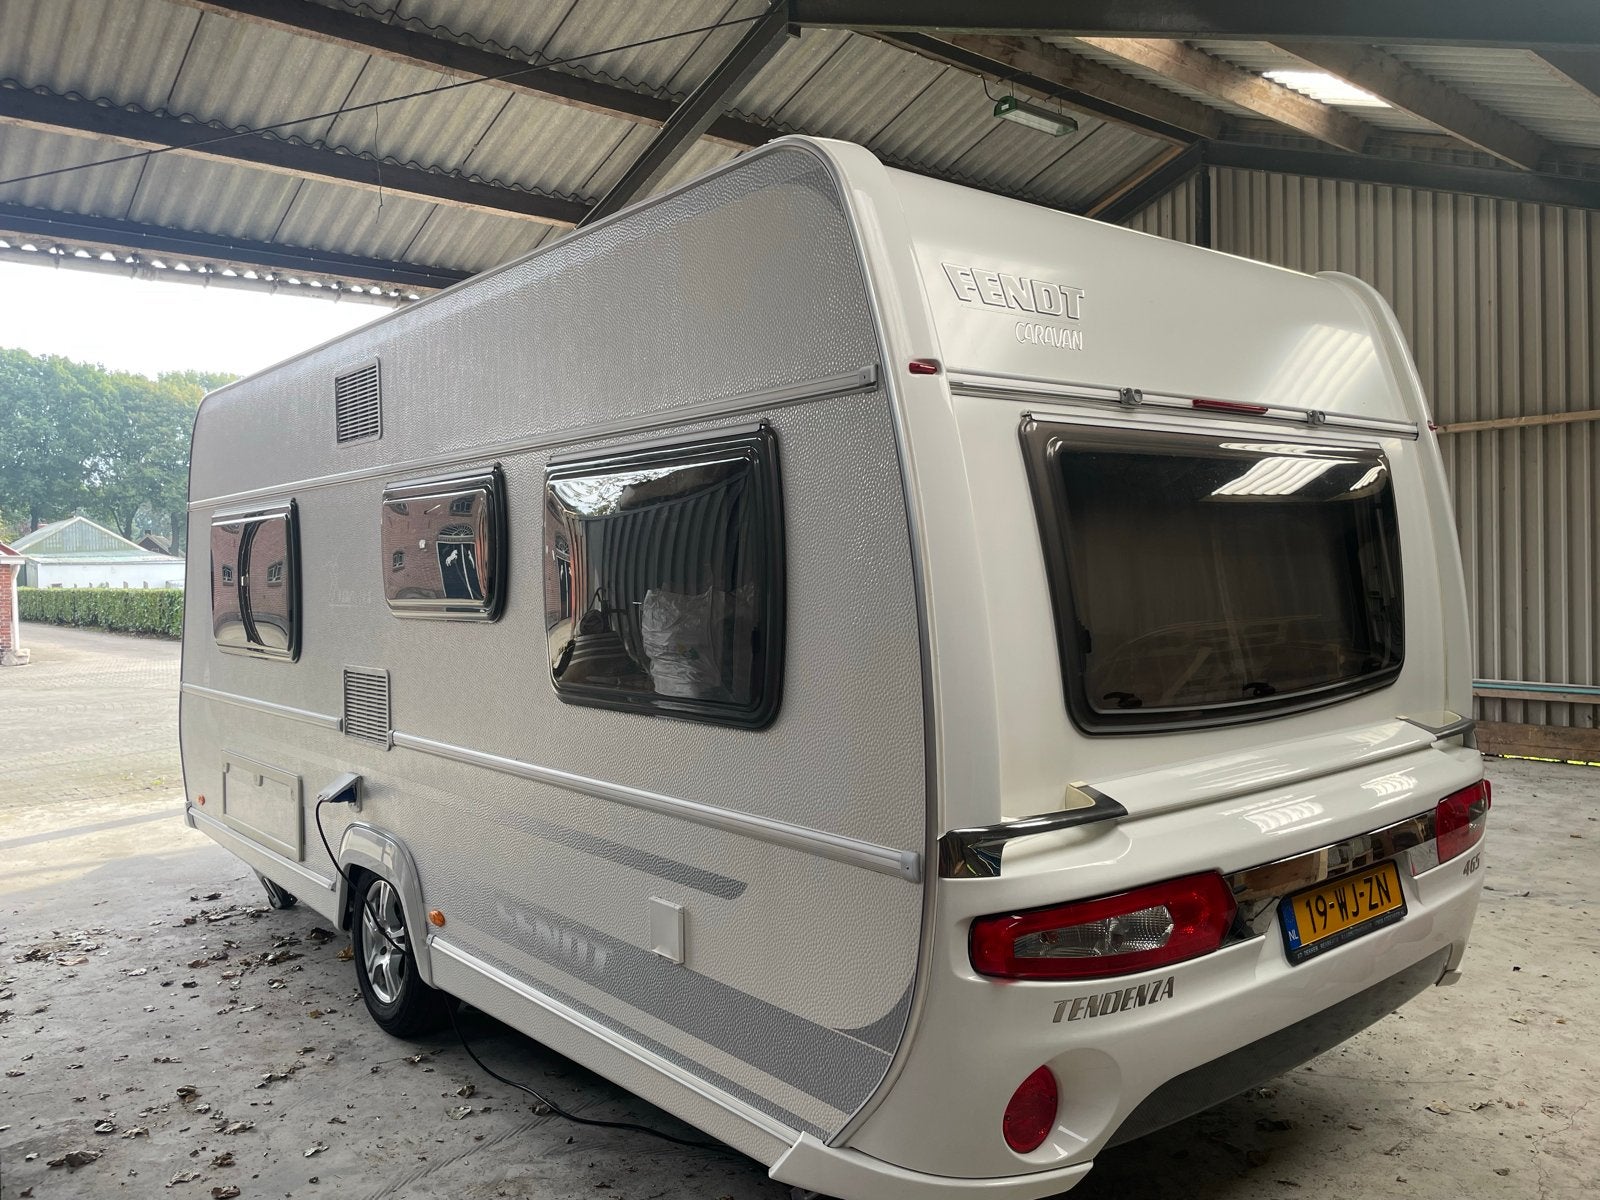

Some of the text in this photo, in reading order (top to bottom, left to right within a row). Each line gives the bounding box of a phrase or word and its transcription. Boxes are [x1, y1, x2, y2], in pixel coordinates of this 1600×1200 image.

[941, 262, 1085, 320] FENDT
[1015, 321, 1083, 351] CARAVAN
[1462, 851, 1481, 877] 465
[1305, 871, 1392, 934] 19-WJ-ZN
[1288, 929, 1300, 942] NL
[1052, 975, 1175, 1024] TENDENZA
